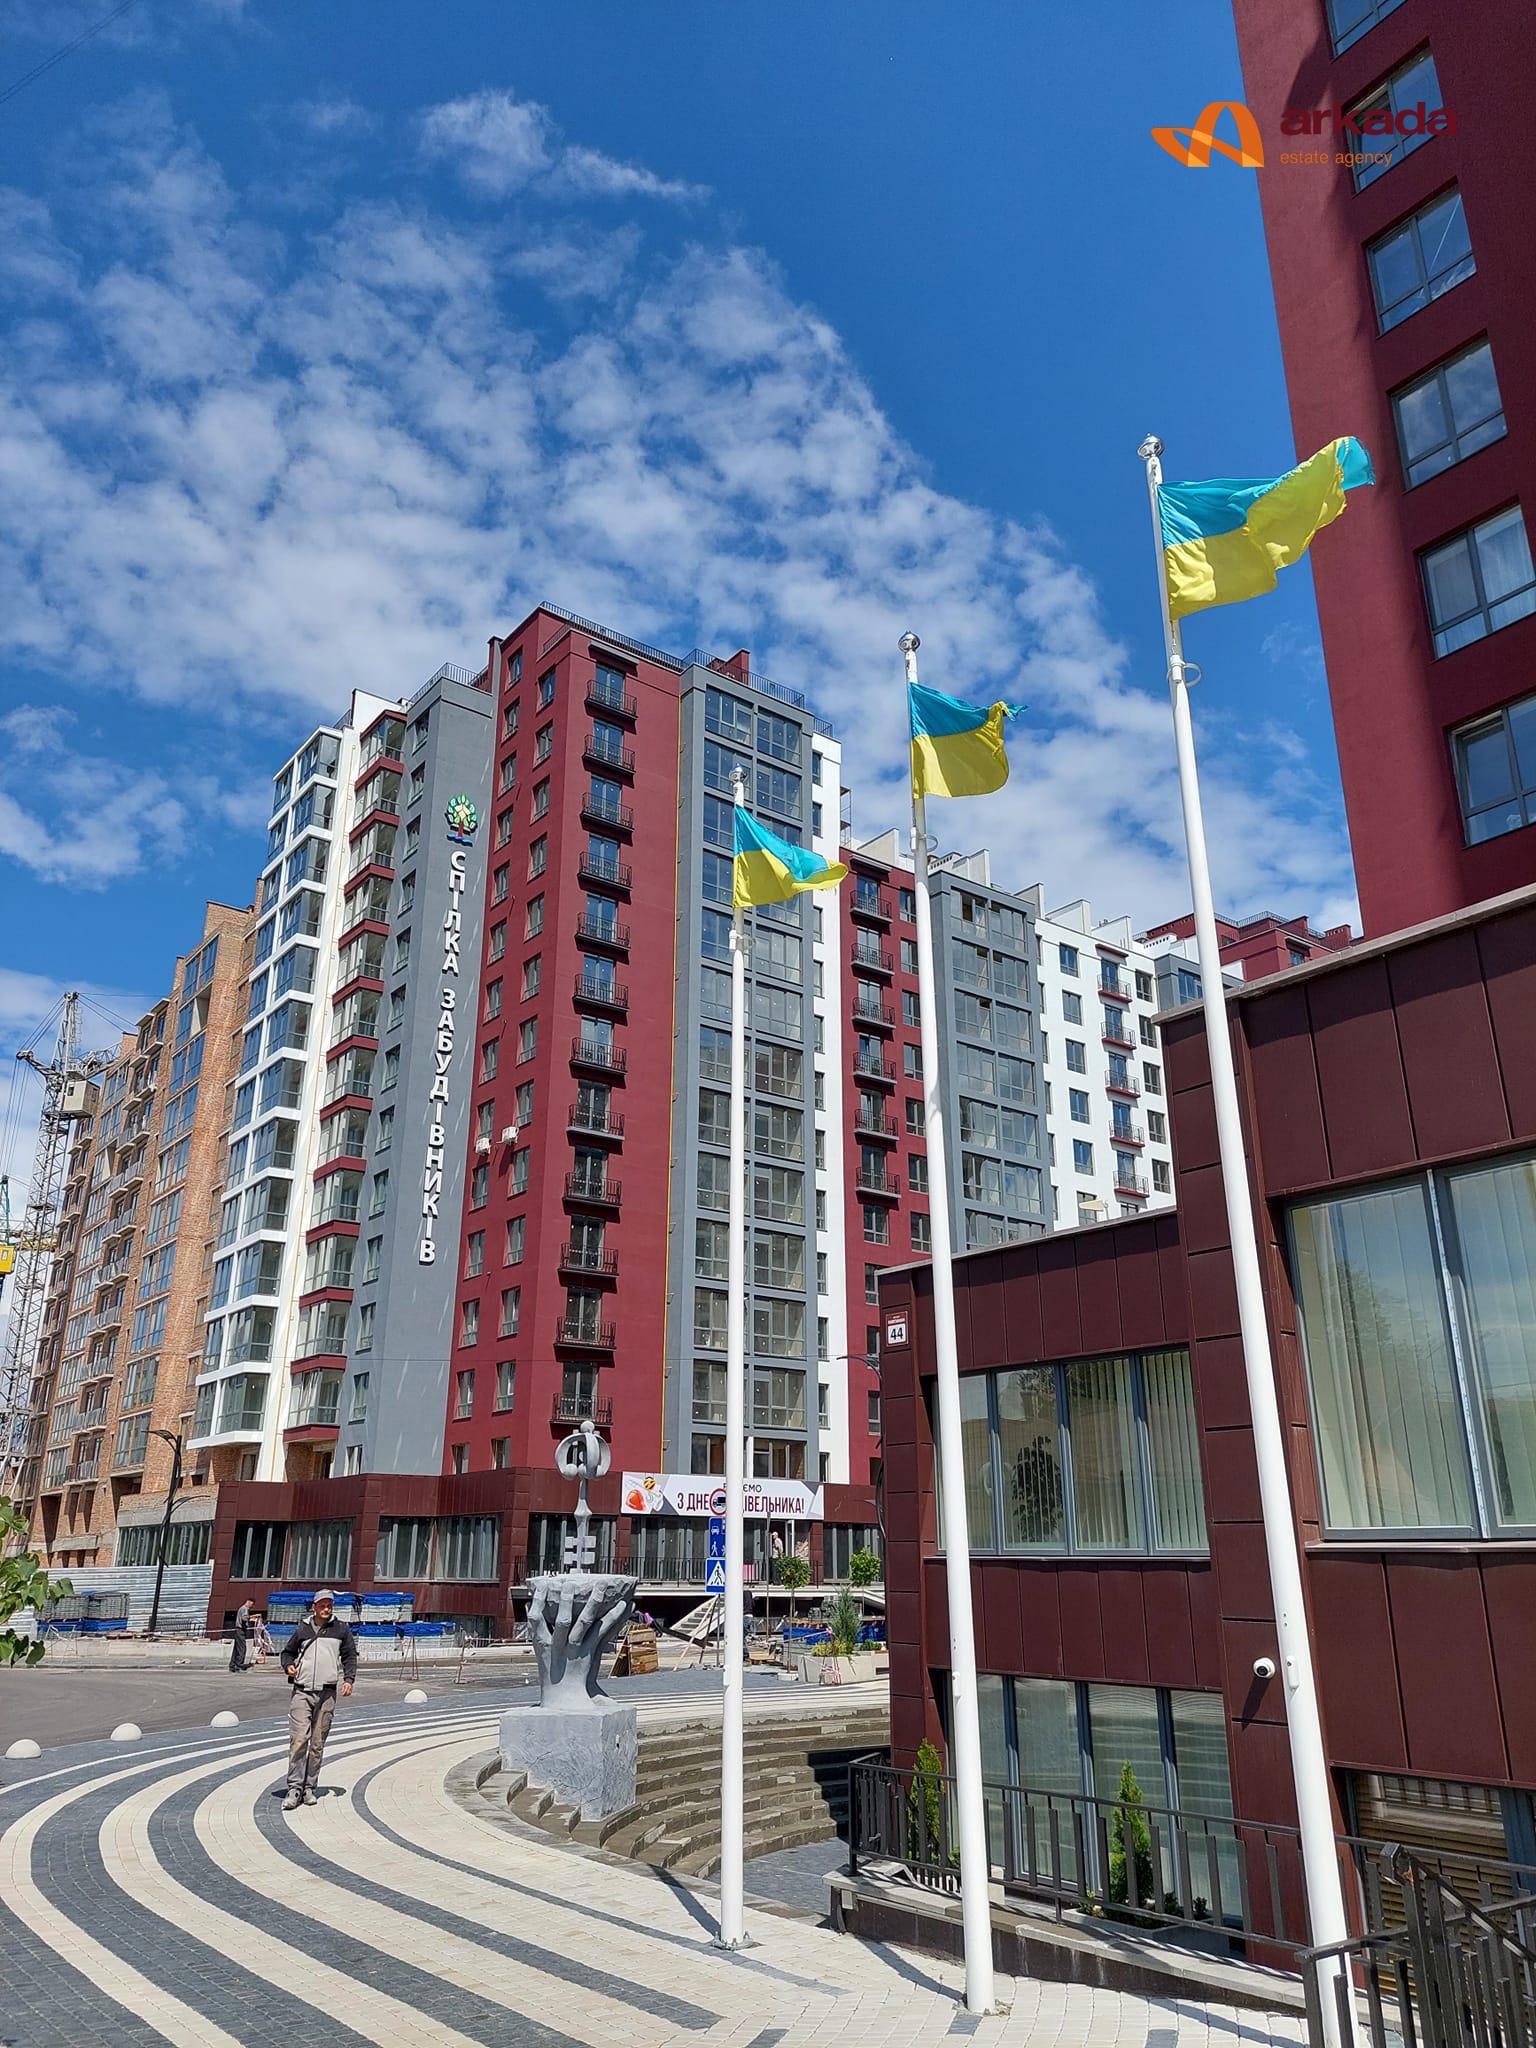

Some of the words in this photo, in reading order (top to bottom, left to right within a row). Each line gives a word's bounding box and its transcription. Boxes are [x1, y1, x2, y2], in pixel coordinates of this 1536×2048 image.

[443, 851, 466, 976] СПІЛКА
[419, 988, 456, 1265] ЗАБУДІВНИКІВ
[890, 1327, 903, 1340] 44
[686, 1493, 710, 1511] ДНЕ
[743, 1495, 805, 1513] ІВЕЛЬНИКА!
